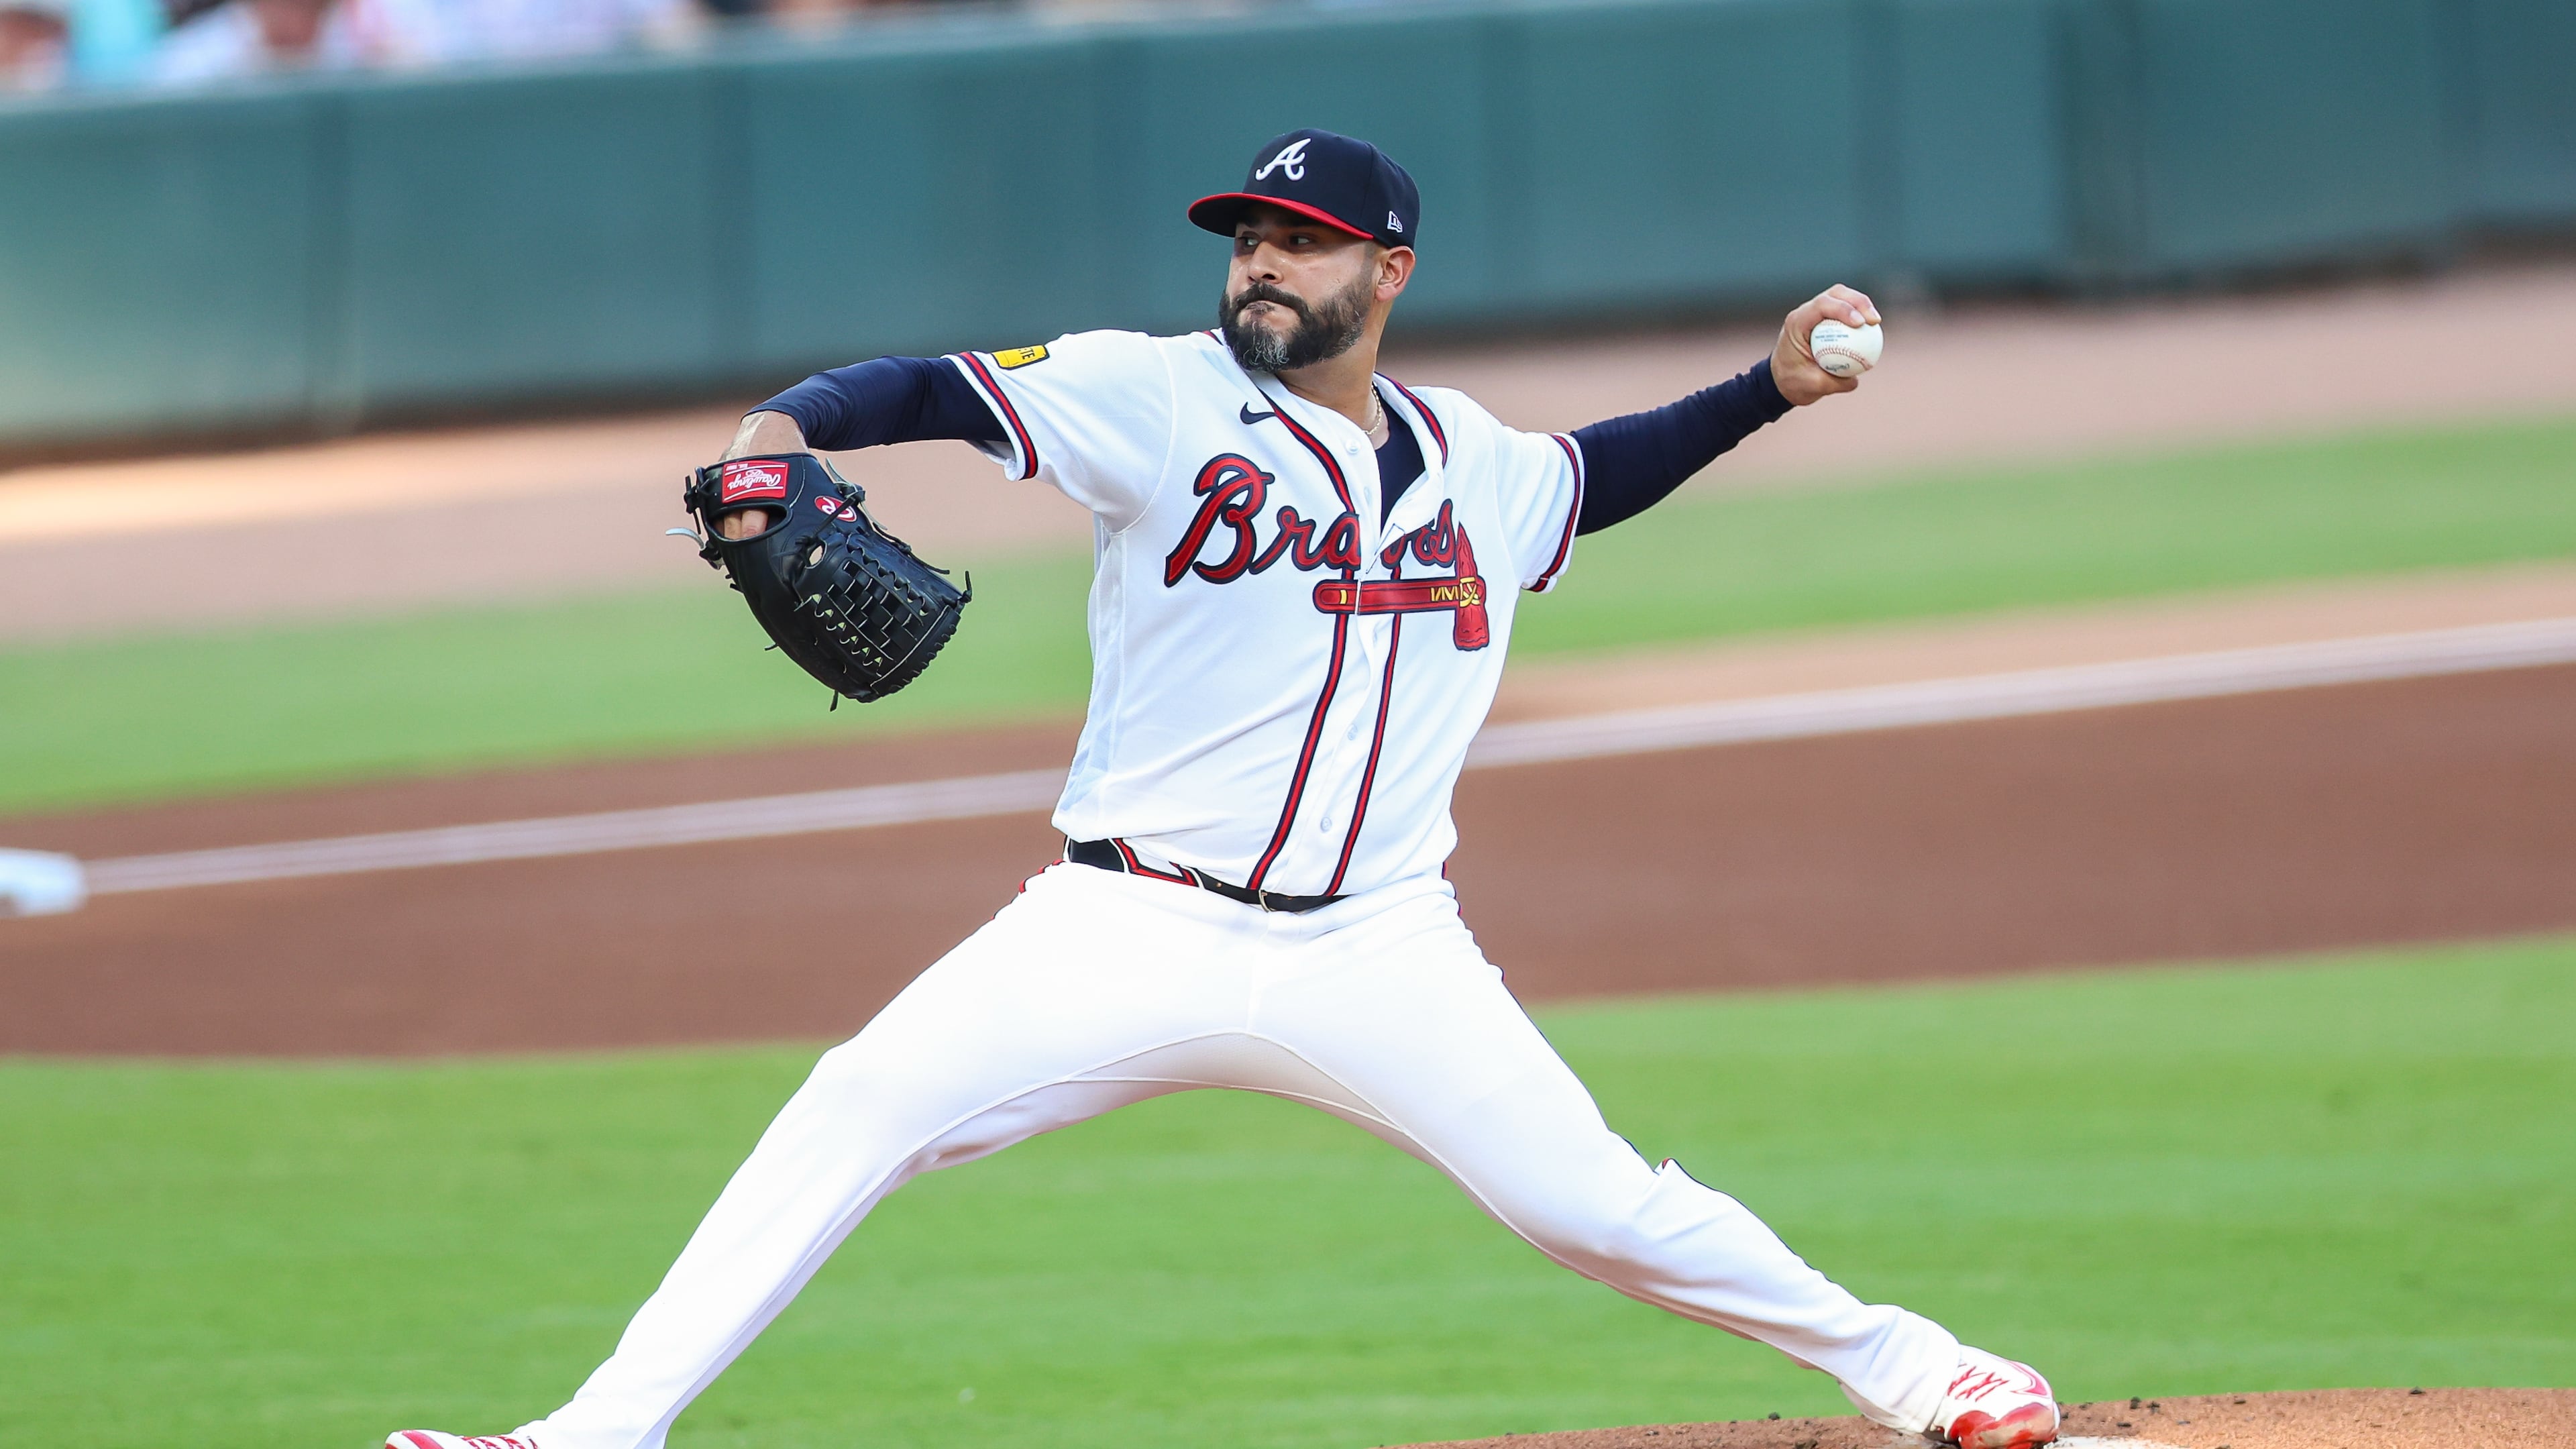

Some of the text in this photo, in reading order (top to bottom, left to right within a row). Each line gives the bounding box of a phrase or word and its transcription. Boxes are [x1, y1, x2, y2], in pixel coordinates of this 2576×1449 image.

[1256, 138, 1311, 180] A
[1018, 347, 1036, 360] TE
[727, 472, 781, 490] Rawlings
